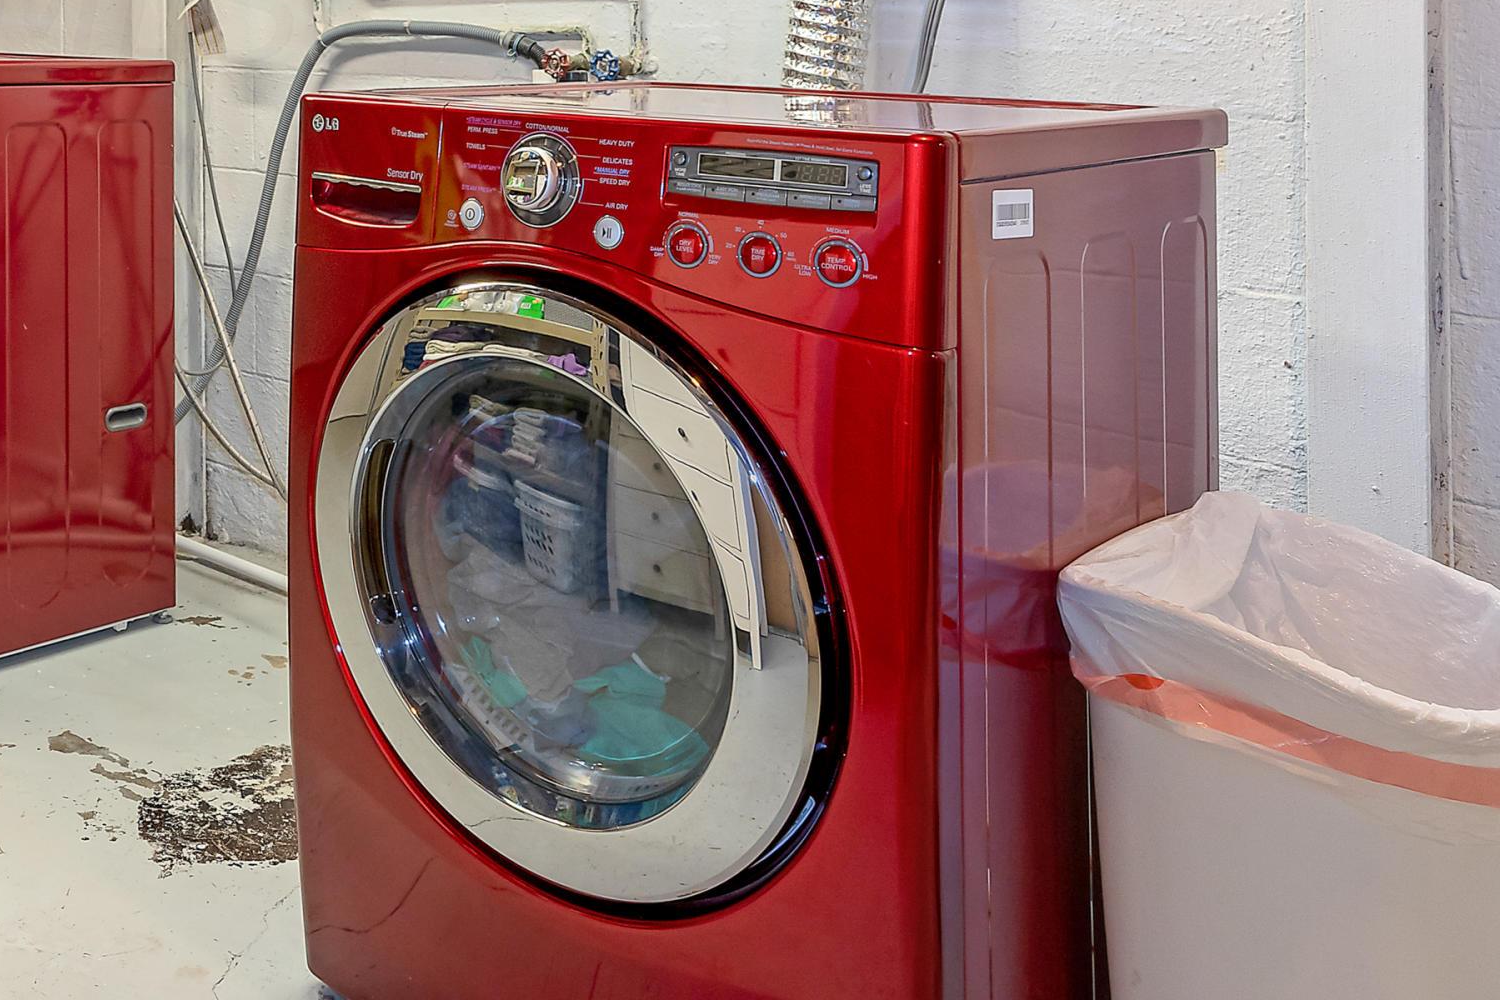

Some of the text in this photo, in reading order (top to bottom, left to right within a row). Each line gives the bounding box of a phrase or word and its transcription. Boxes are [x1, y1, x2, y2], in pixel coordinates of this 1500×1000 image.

[466, 142, 486, 150] TOWELS
[618, 140, 635, 148] DUTY
[602, 157, 633, 165] DELICATES
[387, 168, 423, 182] Sensor Dry
[599, 177, 617, 185] SPEED
[616, 203, 629, 211] DRY
[826, 227, 850, 235] MEDIUM
[675, 246, 694, 254] LEVEL
[751, 254, 764, 262] DRY
[821, 263, 853, 272] CONTROL
